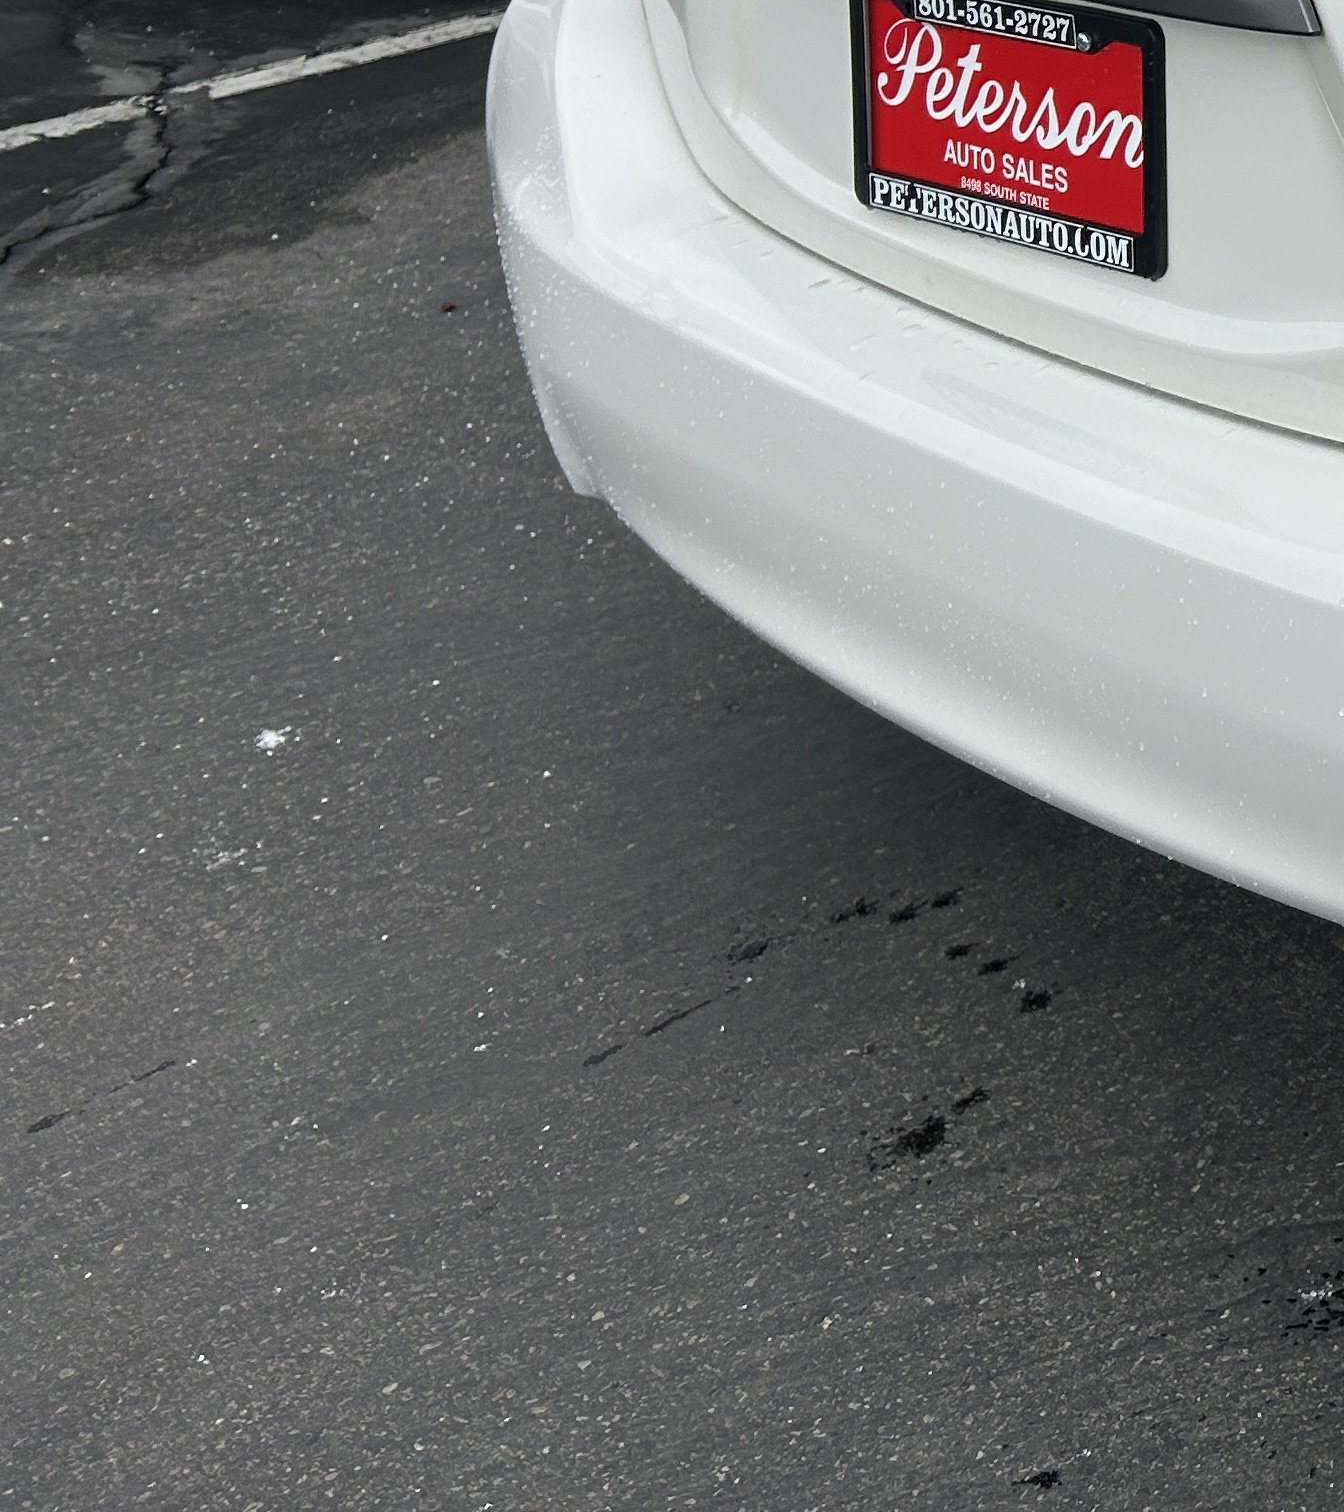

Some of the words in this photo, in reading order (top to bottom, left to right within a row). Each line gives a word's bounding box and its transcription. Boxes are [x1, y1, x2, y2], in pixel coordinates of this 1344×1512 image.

[877, 18, 1144, 169] Peterson
[943, 139, 996, 175] AUTO
[1002, 153, 1069, 194] SALES
[983, 181, 1018, 203] SOUTH
[1019, 191, 1051, 211] STATE
